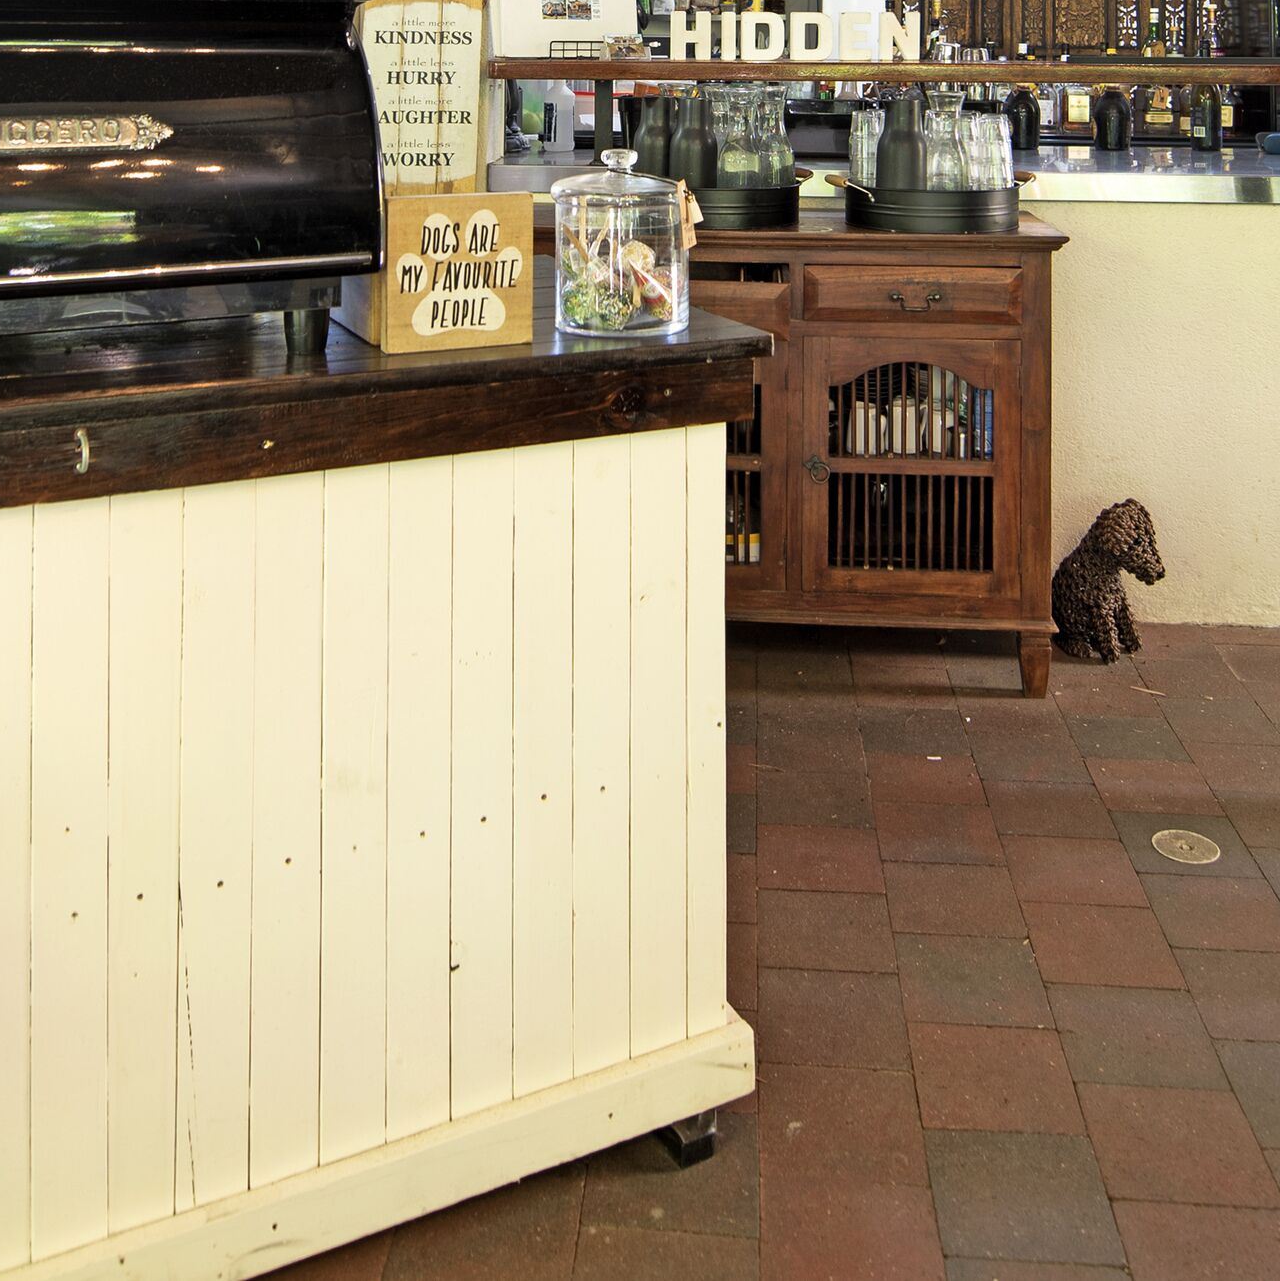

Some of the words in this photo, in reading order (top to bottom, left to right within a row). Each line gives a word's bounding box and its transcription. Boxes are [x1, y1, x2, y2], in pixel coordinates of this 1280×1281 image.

[374, 30, 473, 45] KINDNESS
[670, 10, 921, 62] HIDDEN
[430, 57, 454, 67] less
[387, 71, 456, 85] HURRY
[398, 95, 422, 105] little
[379, 110, 472, 124] AUGHTER
[427, 139, 451, 148] less
[382, 152, 455, 167] WORRY
[421, 222, 460, 256] DOGS
[469, 223, 500, 255] ARE
[400, 264, 423, 294] MY
[432, 259, 519, 293] FAVOURITE
[431, 297, 489, 329] PEOPLE
